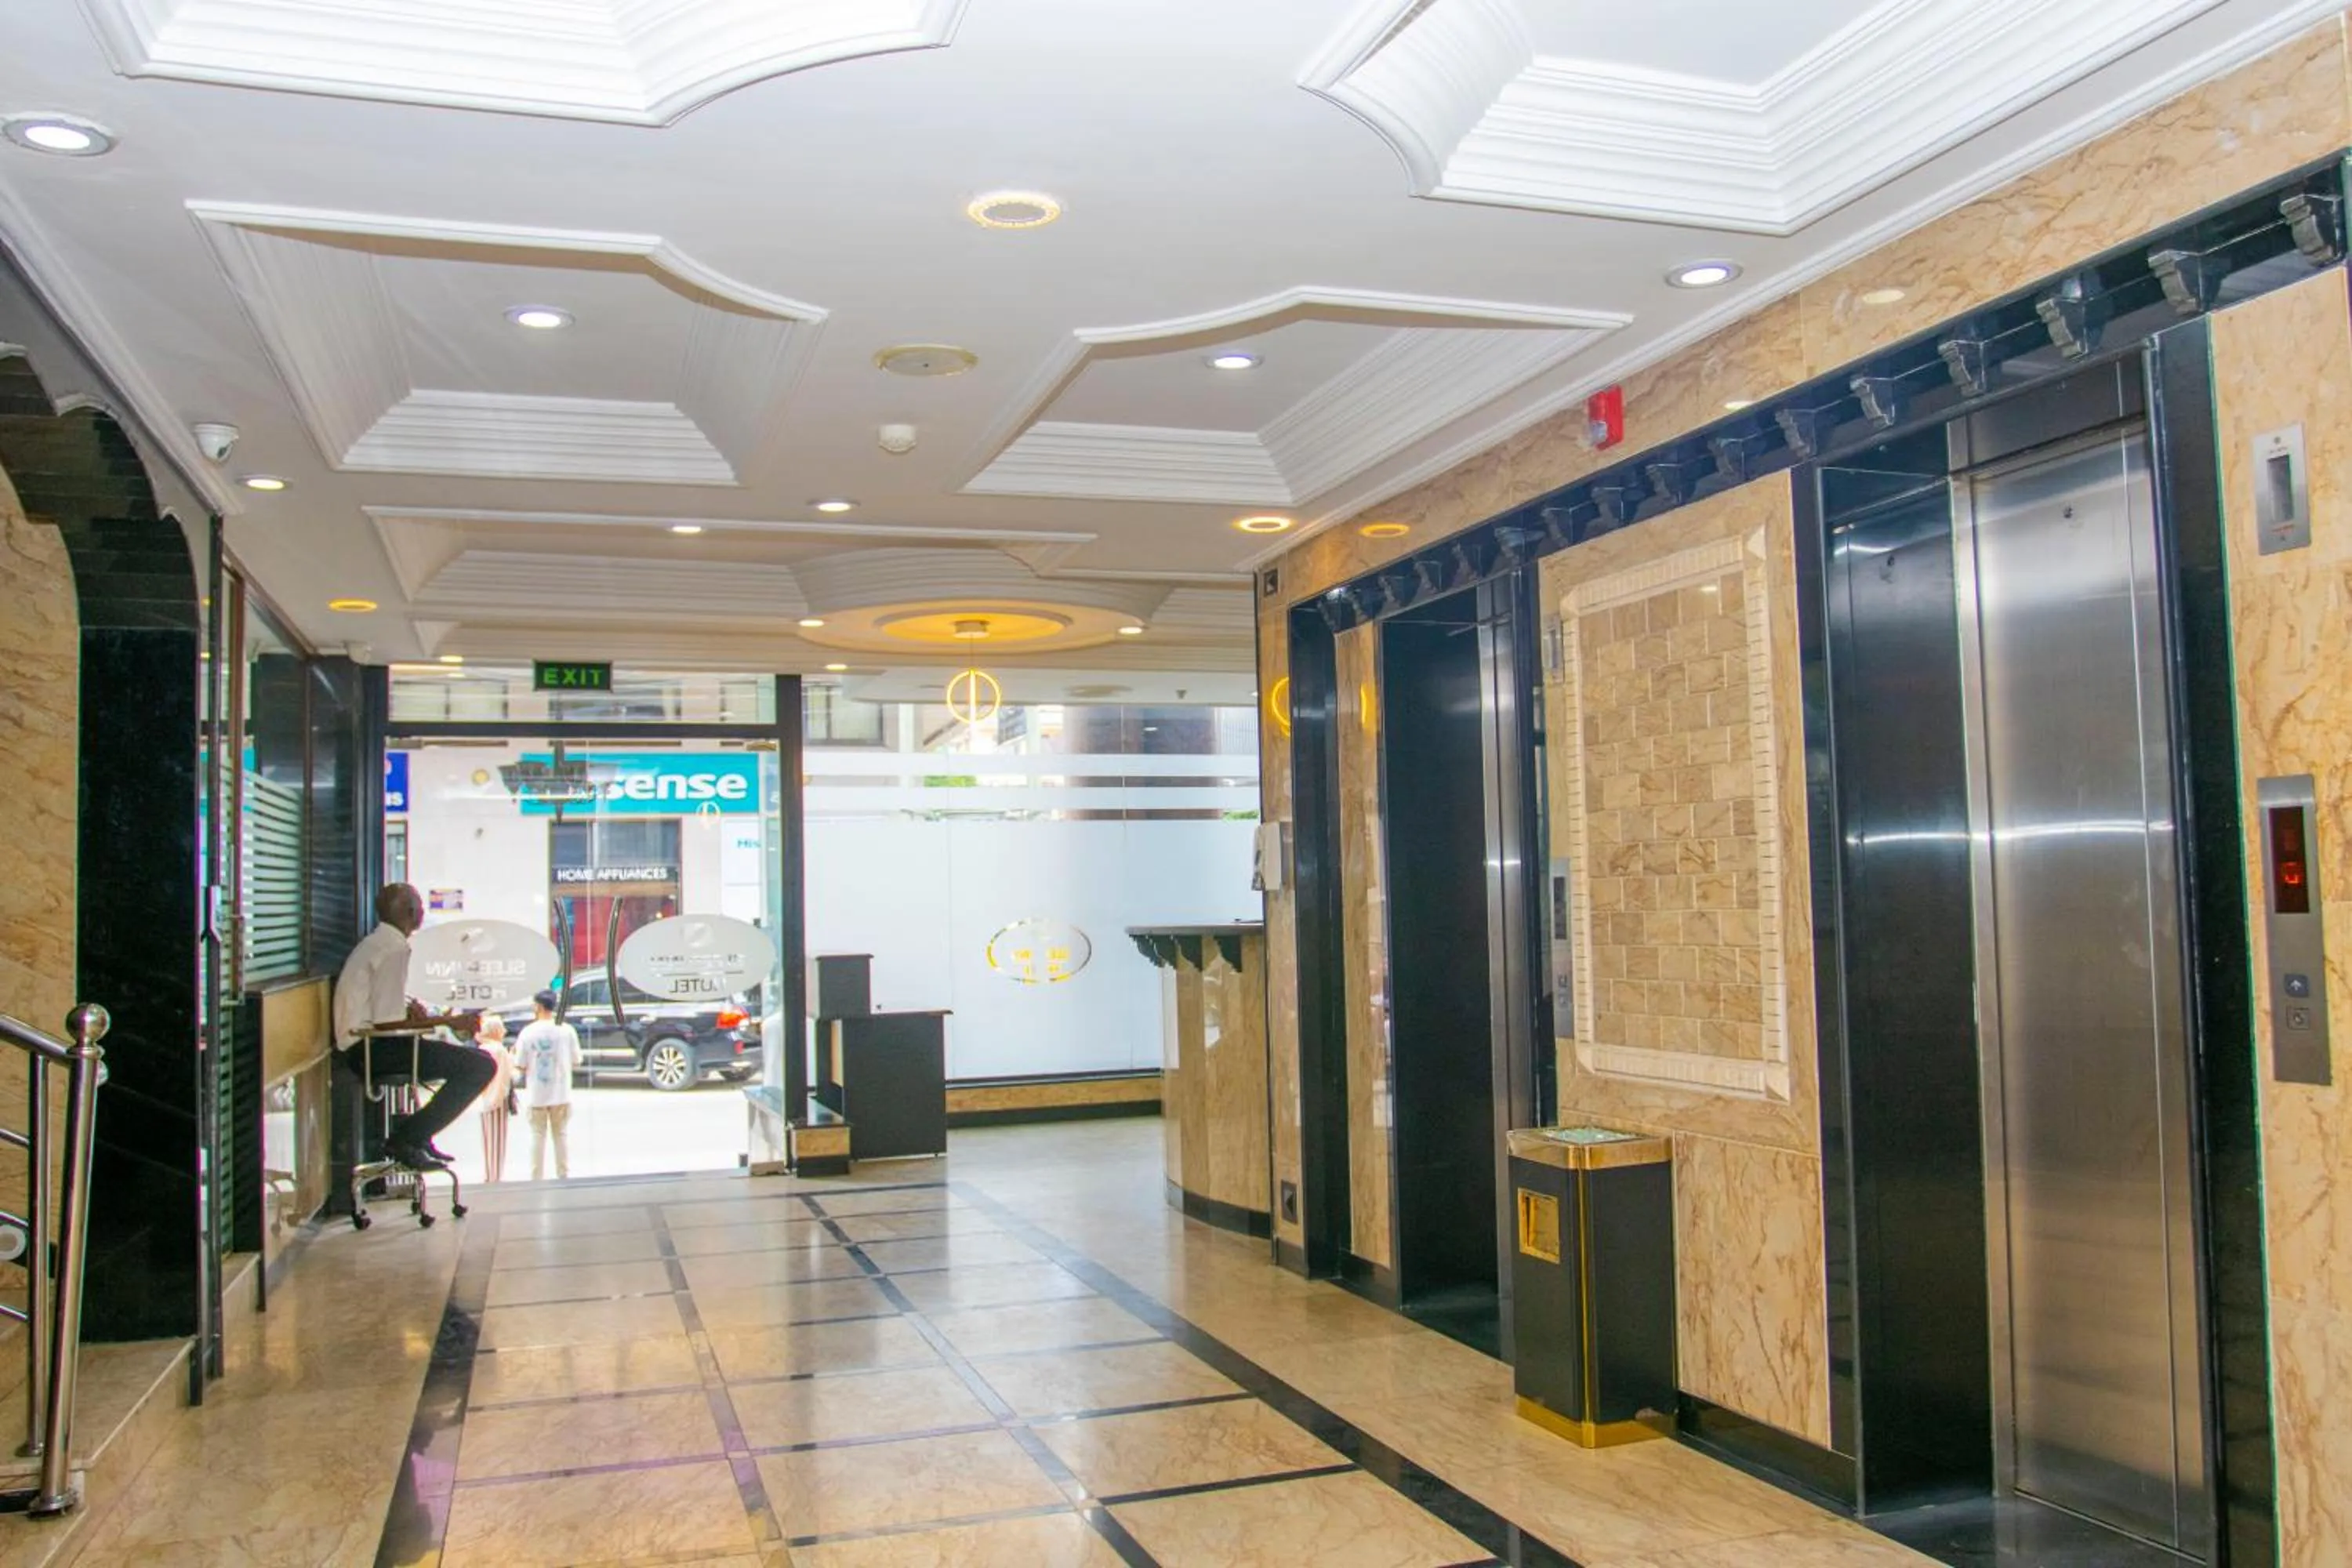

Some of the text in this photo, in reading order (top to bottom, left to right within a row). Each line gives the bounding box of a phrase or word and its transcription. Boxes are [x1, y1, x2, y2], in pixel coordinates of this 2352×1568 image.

[543, 668, 604, 686] EXIT
[596, 772, 749, 800] sense
[557, 867, 668, 880] HOME APPLIANCES
